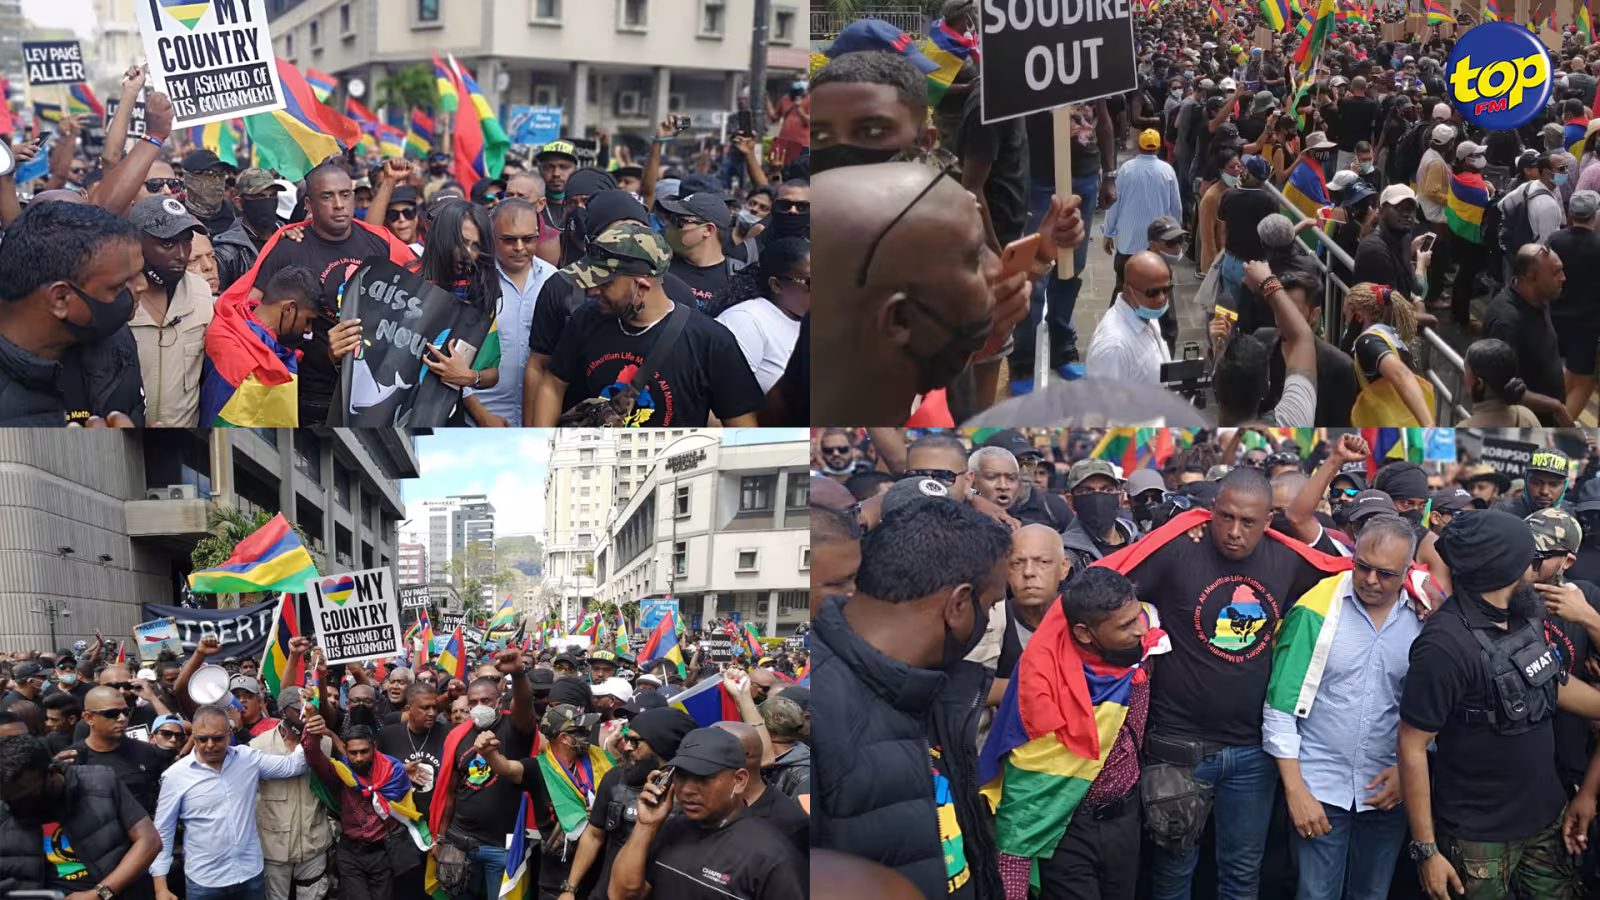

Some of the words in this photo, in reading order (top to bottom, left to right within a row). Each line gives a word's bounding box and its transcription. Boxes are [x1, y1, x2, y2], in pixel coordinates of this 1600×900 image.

[984, 0, 1129, 34] SOUDIRE
[24, 48, 48, 62] LEV
[157, 27, 260, 73] COUNTRY
[30, 62, 85, 82] ALLER
[1024, 37, 1104, 92] OUT
[194, 70, 251, 96] ASHAMED
[252, 66, 267, 85] OF
[174, 97, 197, 118] ITS
[589, 352, 621, 370] Mauritian
[621, 351, 635, 361] Life
[1506, 463, 1520, 474] PA
[1532, 452, 1566, 470] BOSTON
[314, 582, 323, 608] I
[354, 571, 383, 602] MY
[1198, 593, 1207, 604] All
[1204, 575, 1232, 596] Mauritian
[1243, 577, 1266, 593] Matters
[1265, 593, 1274, 602] All
[402, 595, 430, 607] ALLER
[320, 602, 388, 632] COUNTRY
[1193, 605, 1203, 631] Matters
[341, 631, 379, 644] ASHAMED
[382, 626, 394, 639] OF
[327, 646, 341, 659] ITS
[1245, 640, 1267, 659] Matters
[1525, 651, 1553, 677] SWAT
[409, 751, 424, 760] ONE
